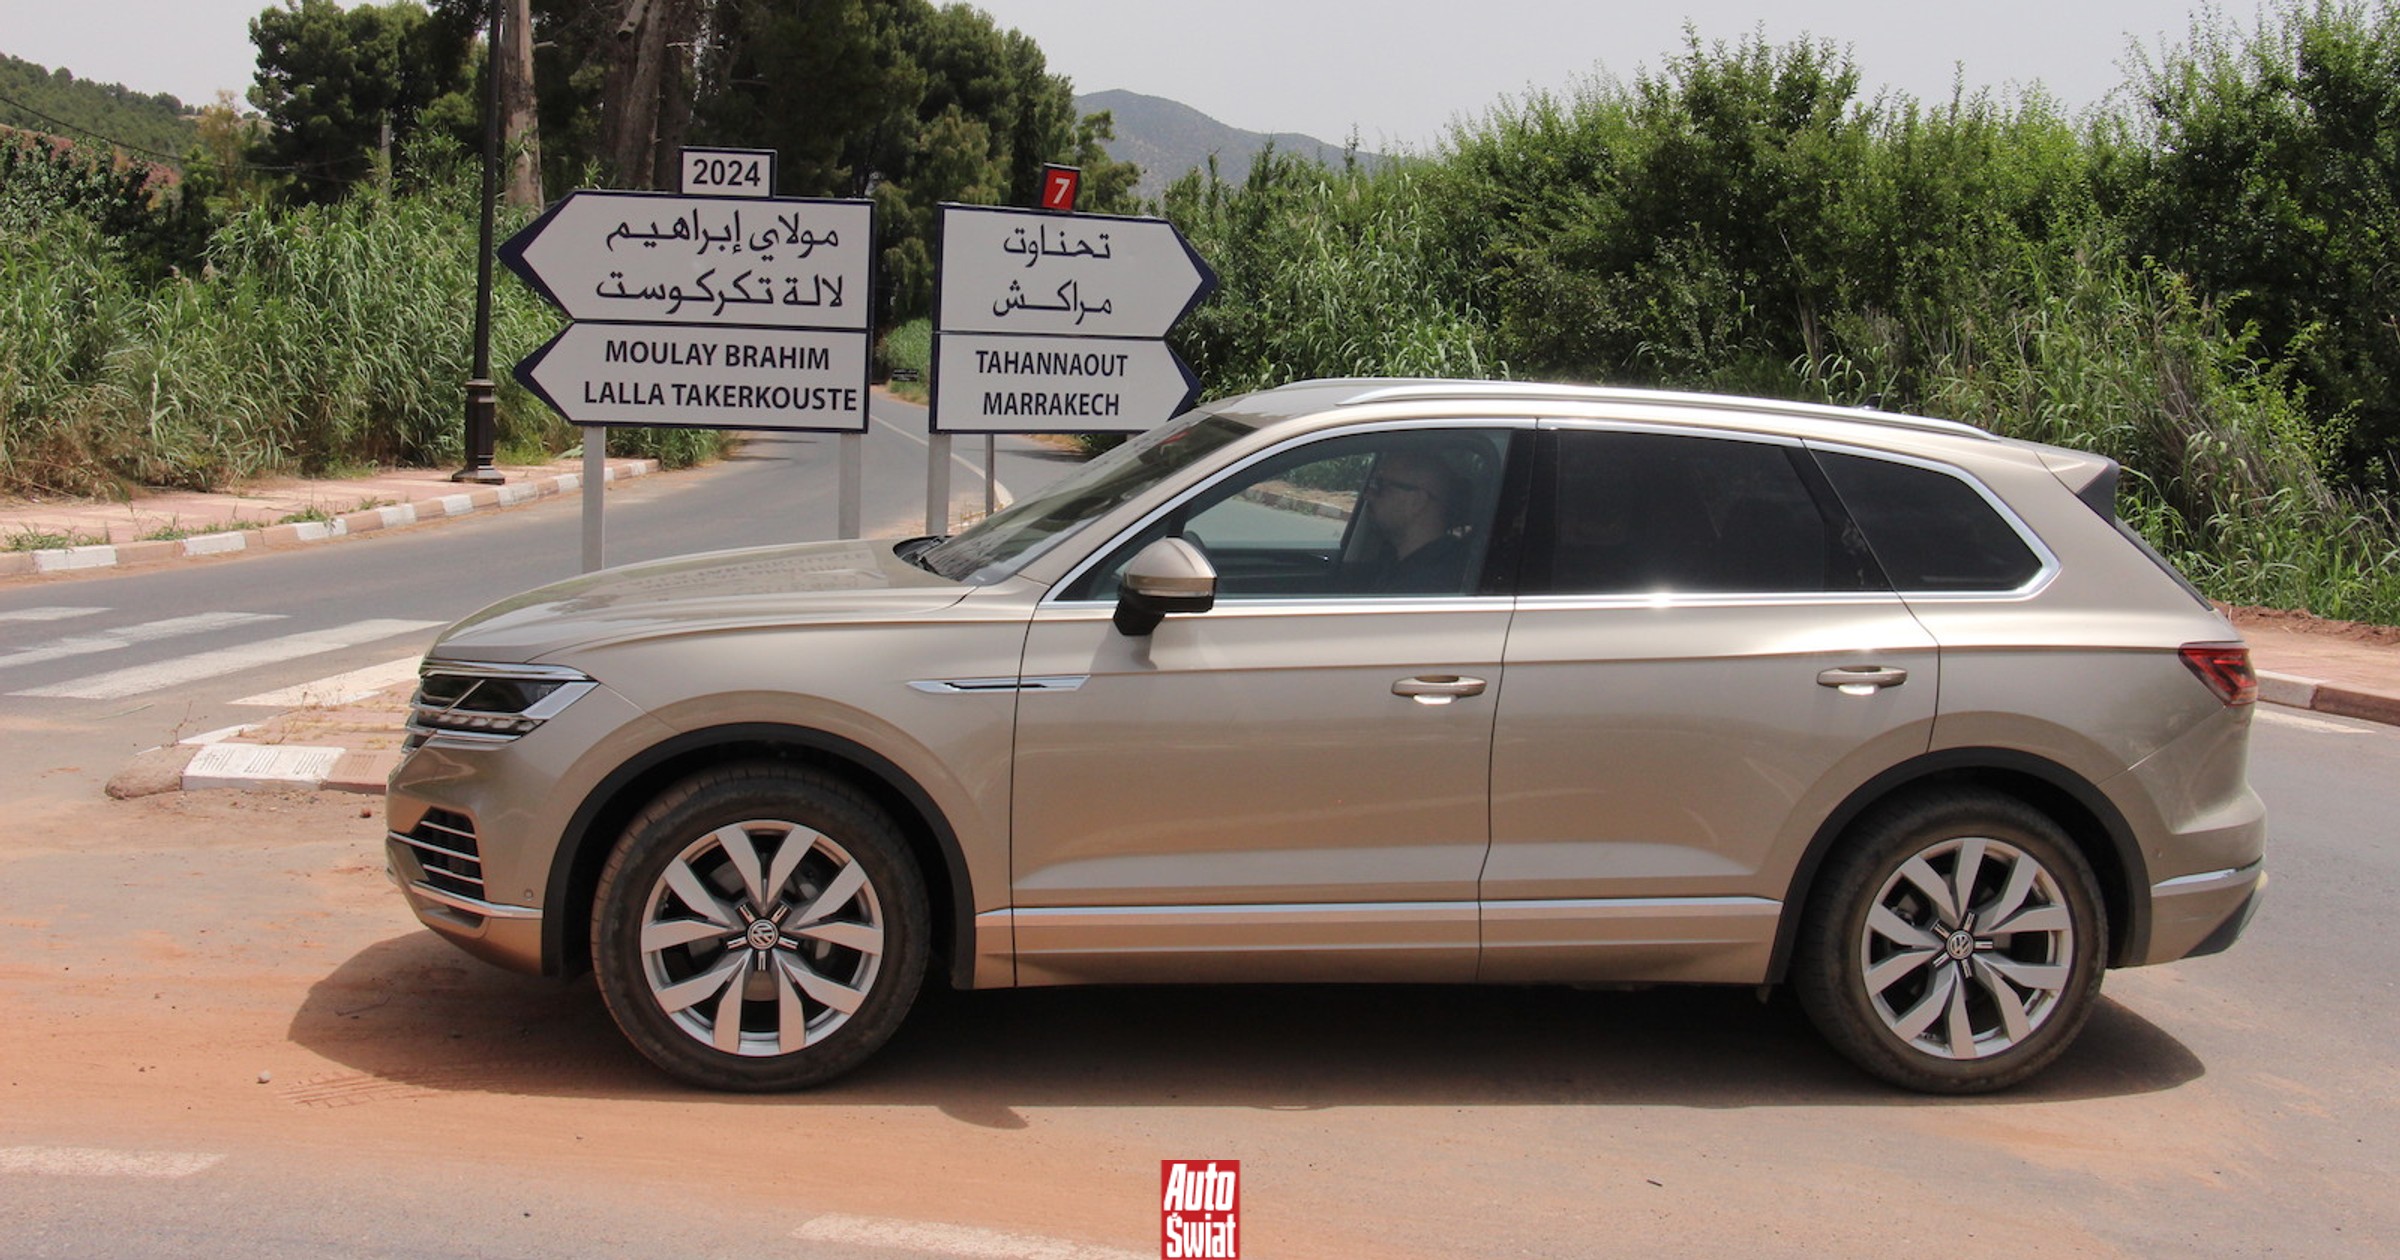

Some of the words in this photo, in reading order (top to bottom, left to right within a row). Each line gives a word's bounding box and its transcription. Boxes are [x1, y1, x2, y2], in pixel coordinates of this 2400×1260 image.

[692, 158, 761, 187] 2024
[1053, 177, 1070, 204] 7
[606, 208, 742, 255] إبراهيم
[749, 211, 839, 262] مولاي
[1003, 223, 1111, 268] تحناوت
[596, 267, 774, 317] تكركوست
[782, 273, 843, 308] لالة
[993, 279, 1112, 326] مراكش
[605, 339, 718, 367] MOULAY
[725, 344, 830, 371] BRAHIM
[975, 350, 1129, 377] TAHANNAOUT
[584, 380, 665, 406] LALLA
[671, 383, 857, 411] TAKERKOUSTE
[983, 391, 1119, 416] MARRAKECH
